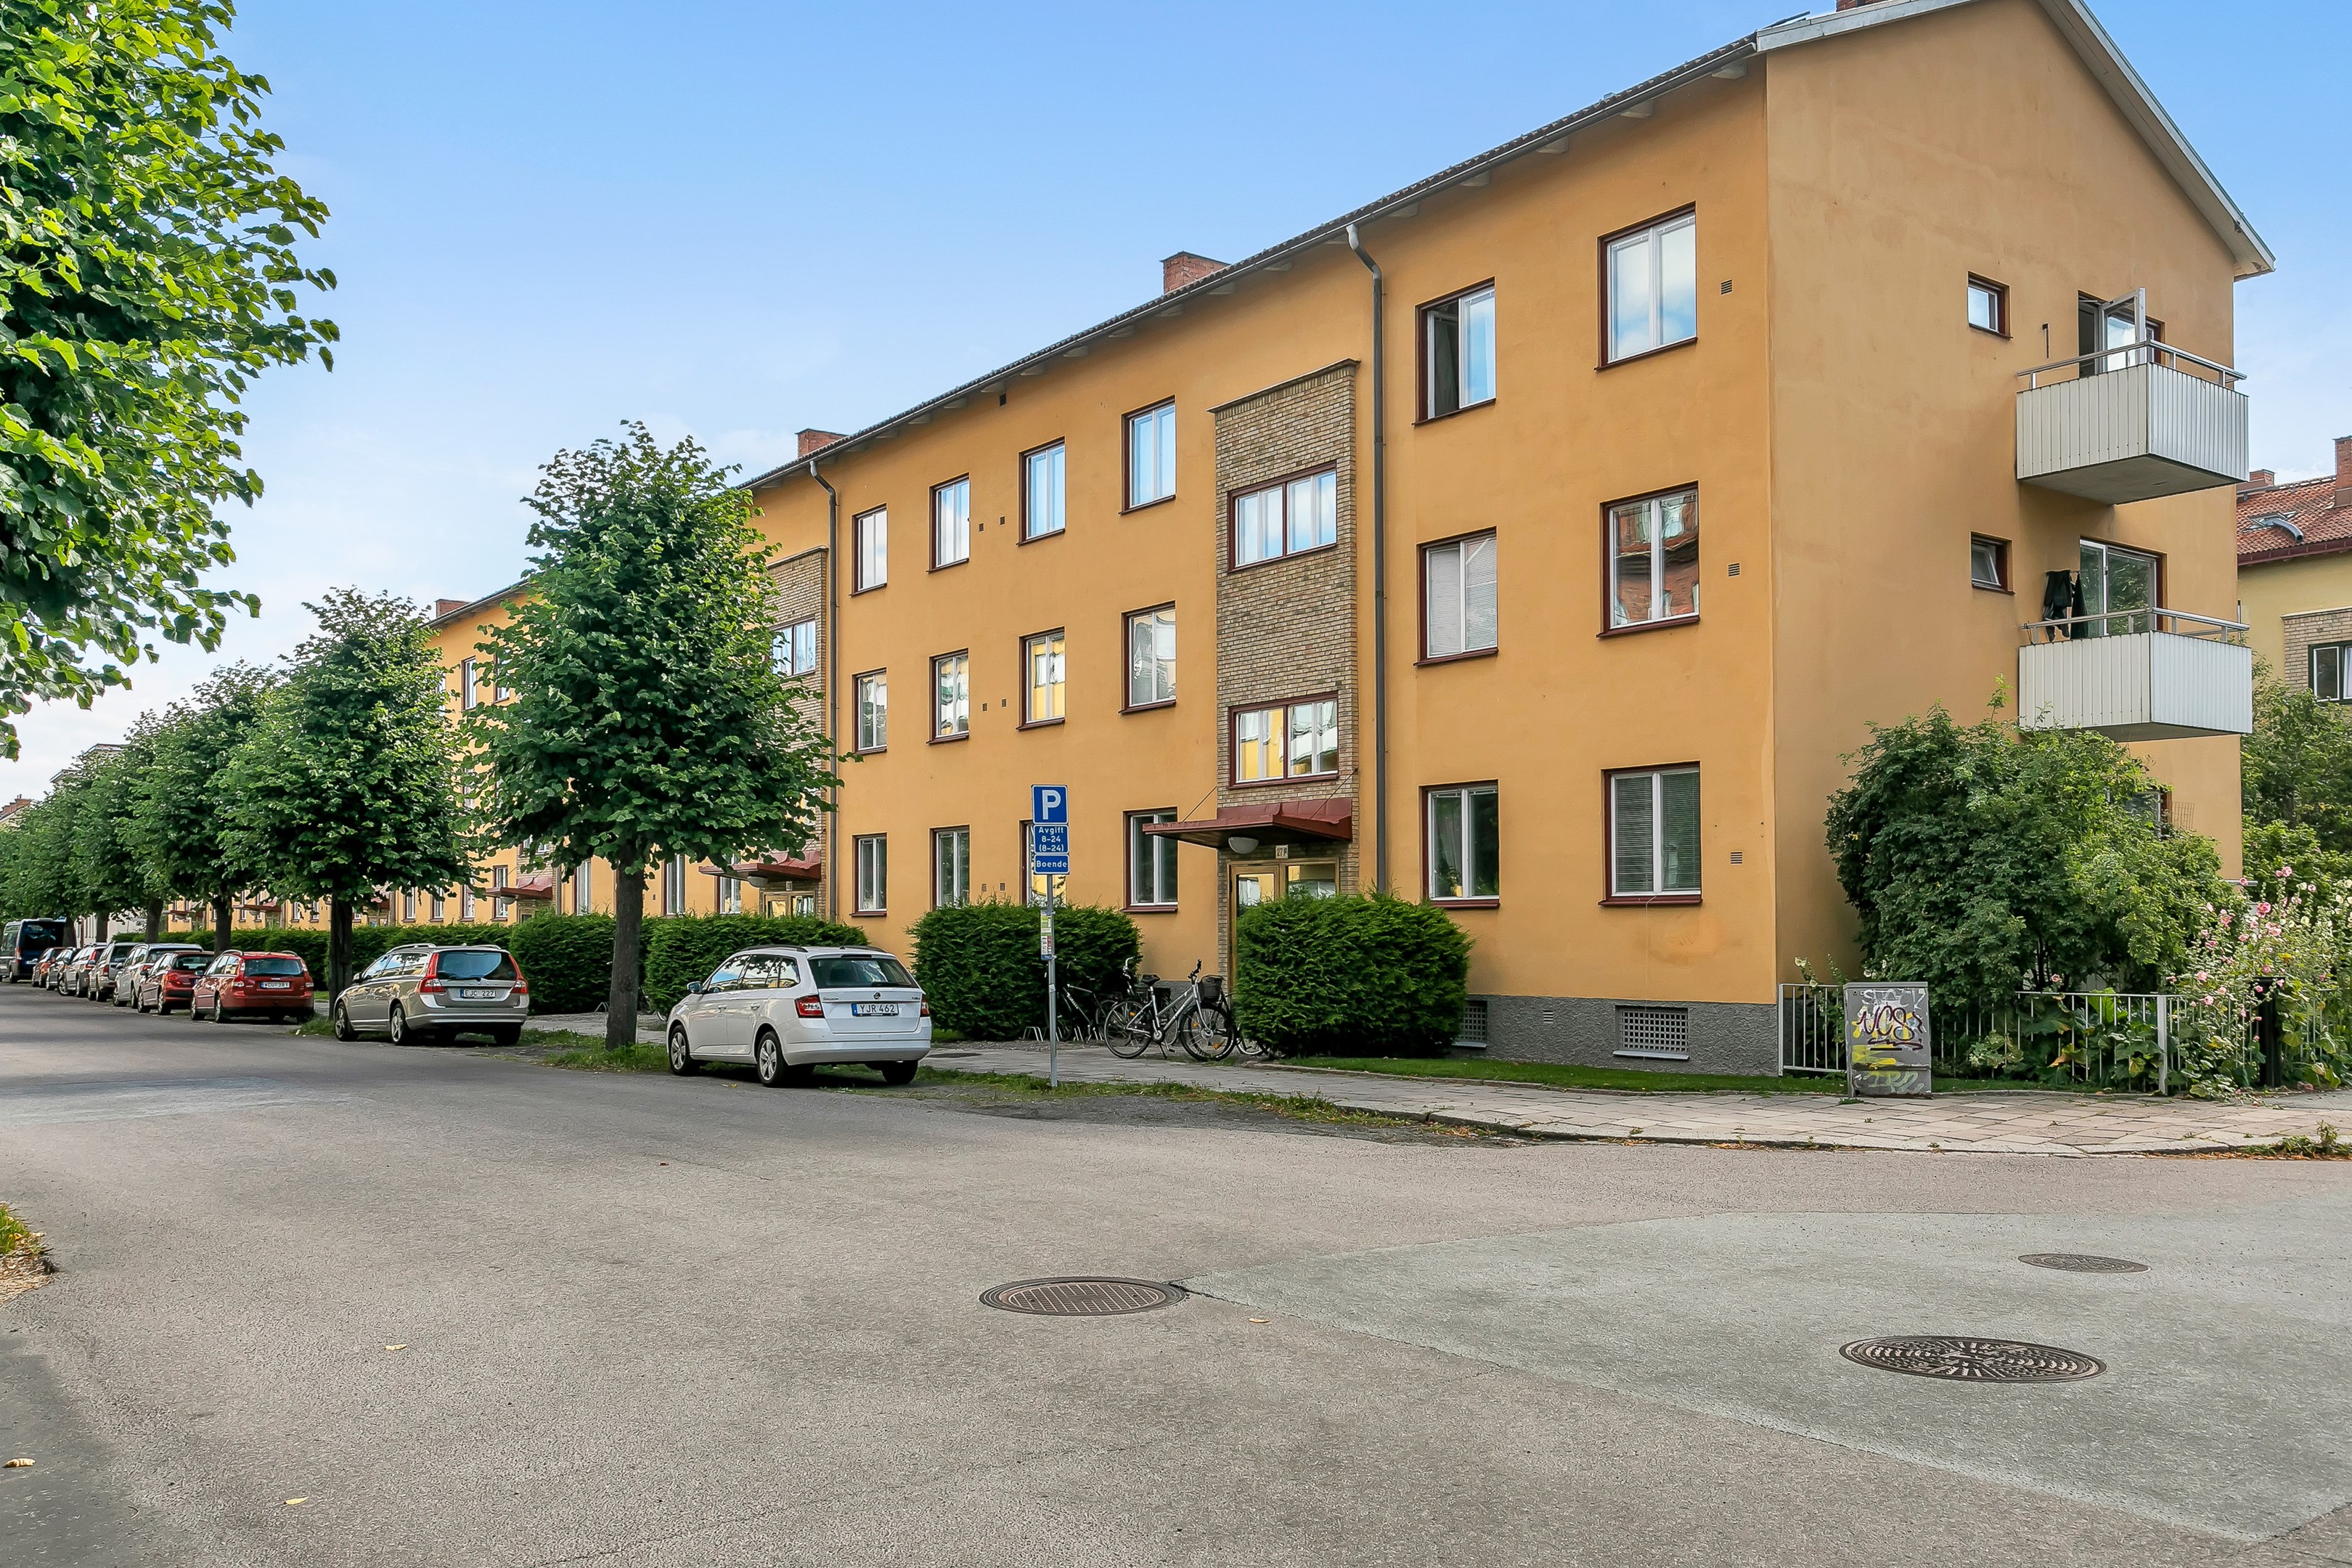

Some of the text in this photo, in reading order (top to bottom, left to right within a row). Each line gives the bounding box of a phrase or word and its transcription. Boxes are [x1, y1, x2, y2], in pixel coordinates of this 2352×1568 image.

[1042, 789, 1061, 820] P
[1038, 826, 1063, 835] Avgift
[1039, 844, 1064, 852] (8-24)
[859, 1004, 895, 1013] YJR 462
